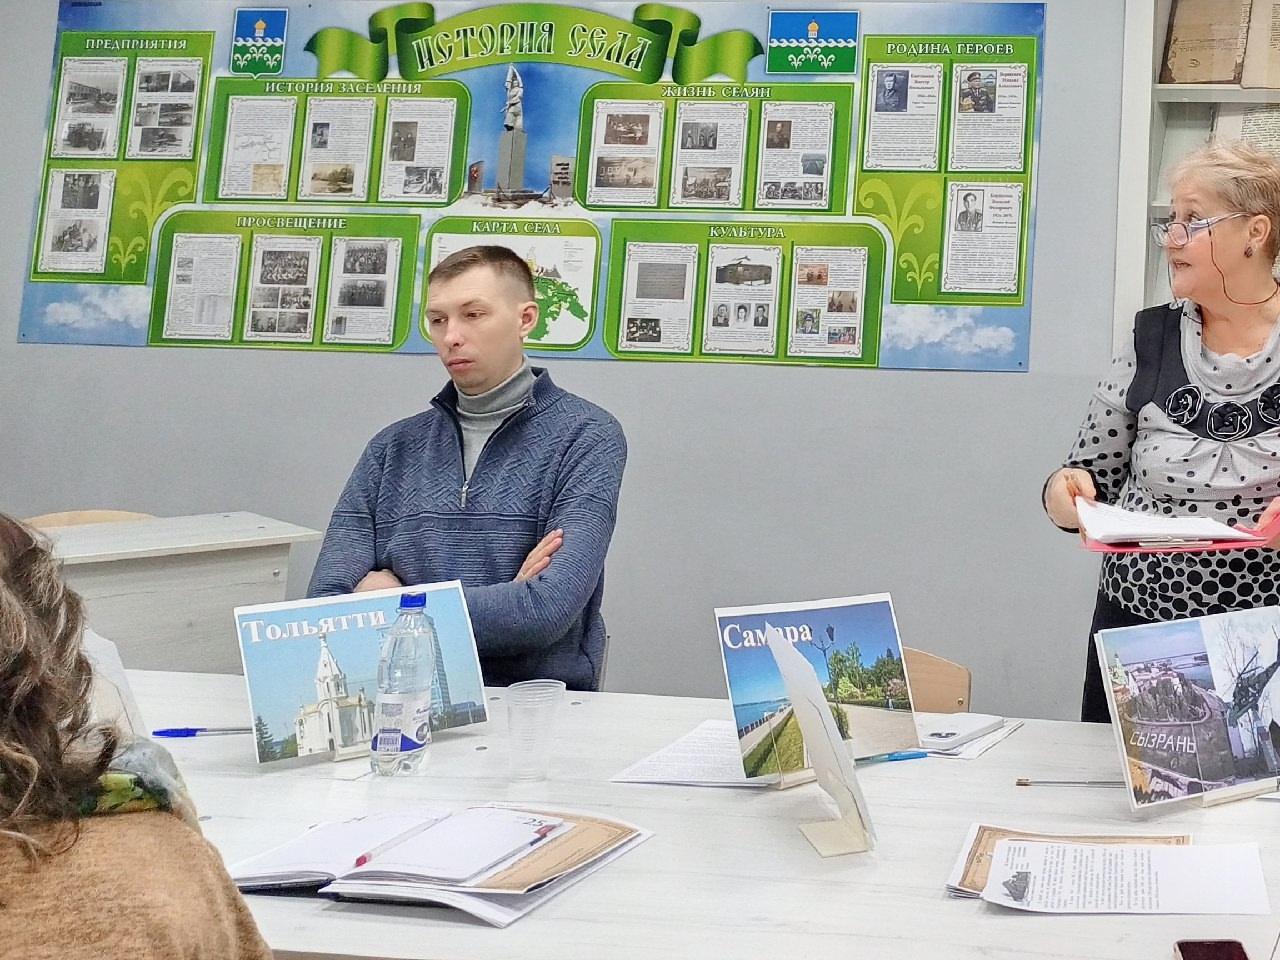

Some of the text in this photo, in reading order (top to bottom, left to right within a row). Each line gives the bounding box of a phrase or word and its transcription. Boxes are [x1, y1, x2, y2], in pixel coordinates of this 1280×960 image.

[85, 39, 188, 50] ПРЕДПРИЯТИЯ
[411, 21, 653, 73] ИСТОРИЯ СЕЛА
[886, 43, 1014, 56] РОДИНА ГЕРОЕВ
[265, 82, 423, 94] ИСТОРИЯ ЗАСЕЛЕНИЯ
[661, 86, 771, 98] ЖИЗНЬ СЕЛЯН
[236, 216, 347, 230] ПРОСВЕЩЕНИЕ
[471, 221, 561, 234] КАРТА СЕЛА
[708, 226, 786, 238] КУЛЬТУРА
[241, 610, 387, 644] Тольятти
[723, 624, 814, 649] Самра
[1129, 731, 1198, 754] СЫЗРАНЬ
